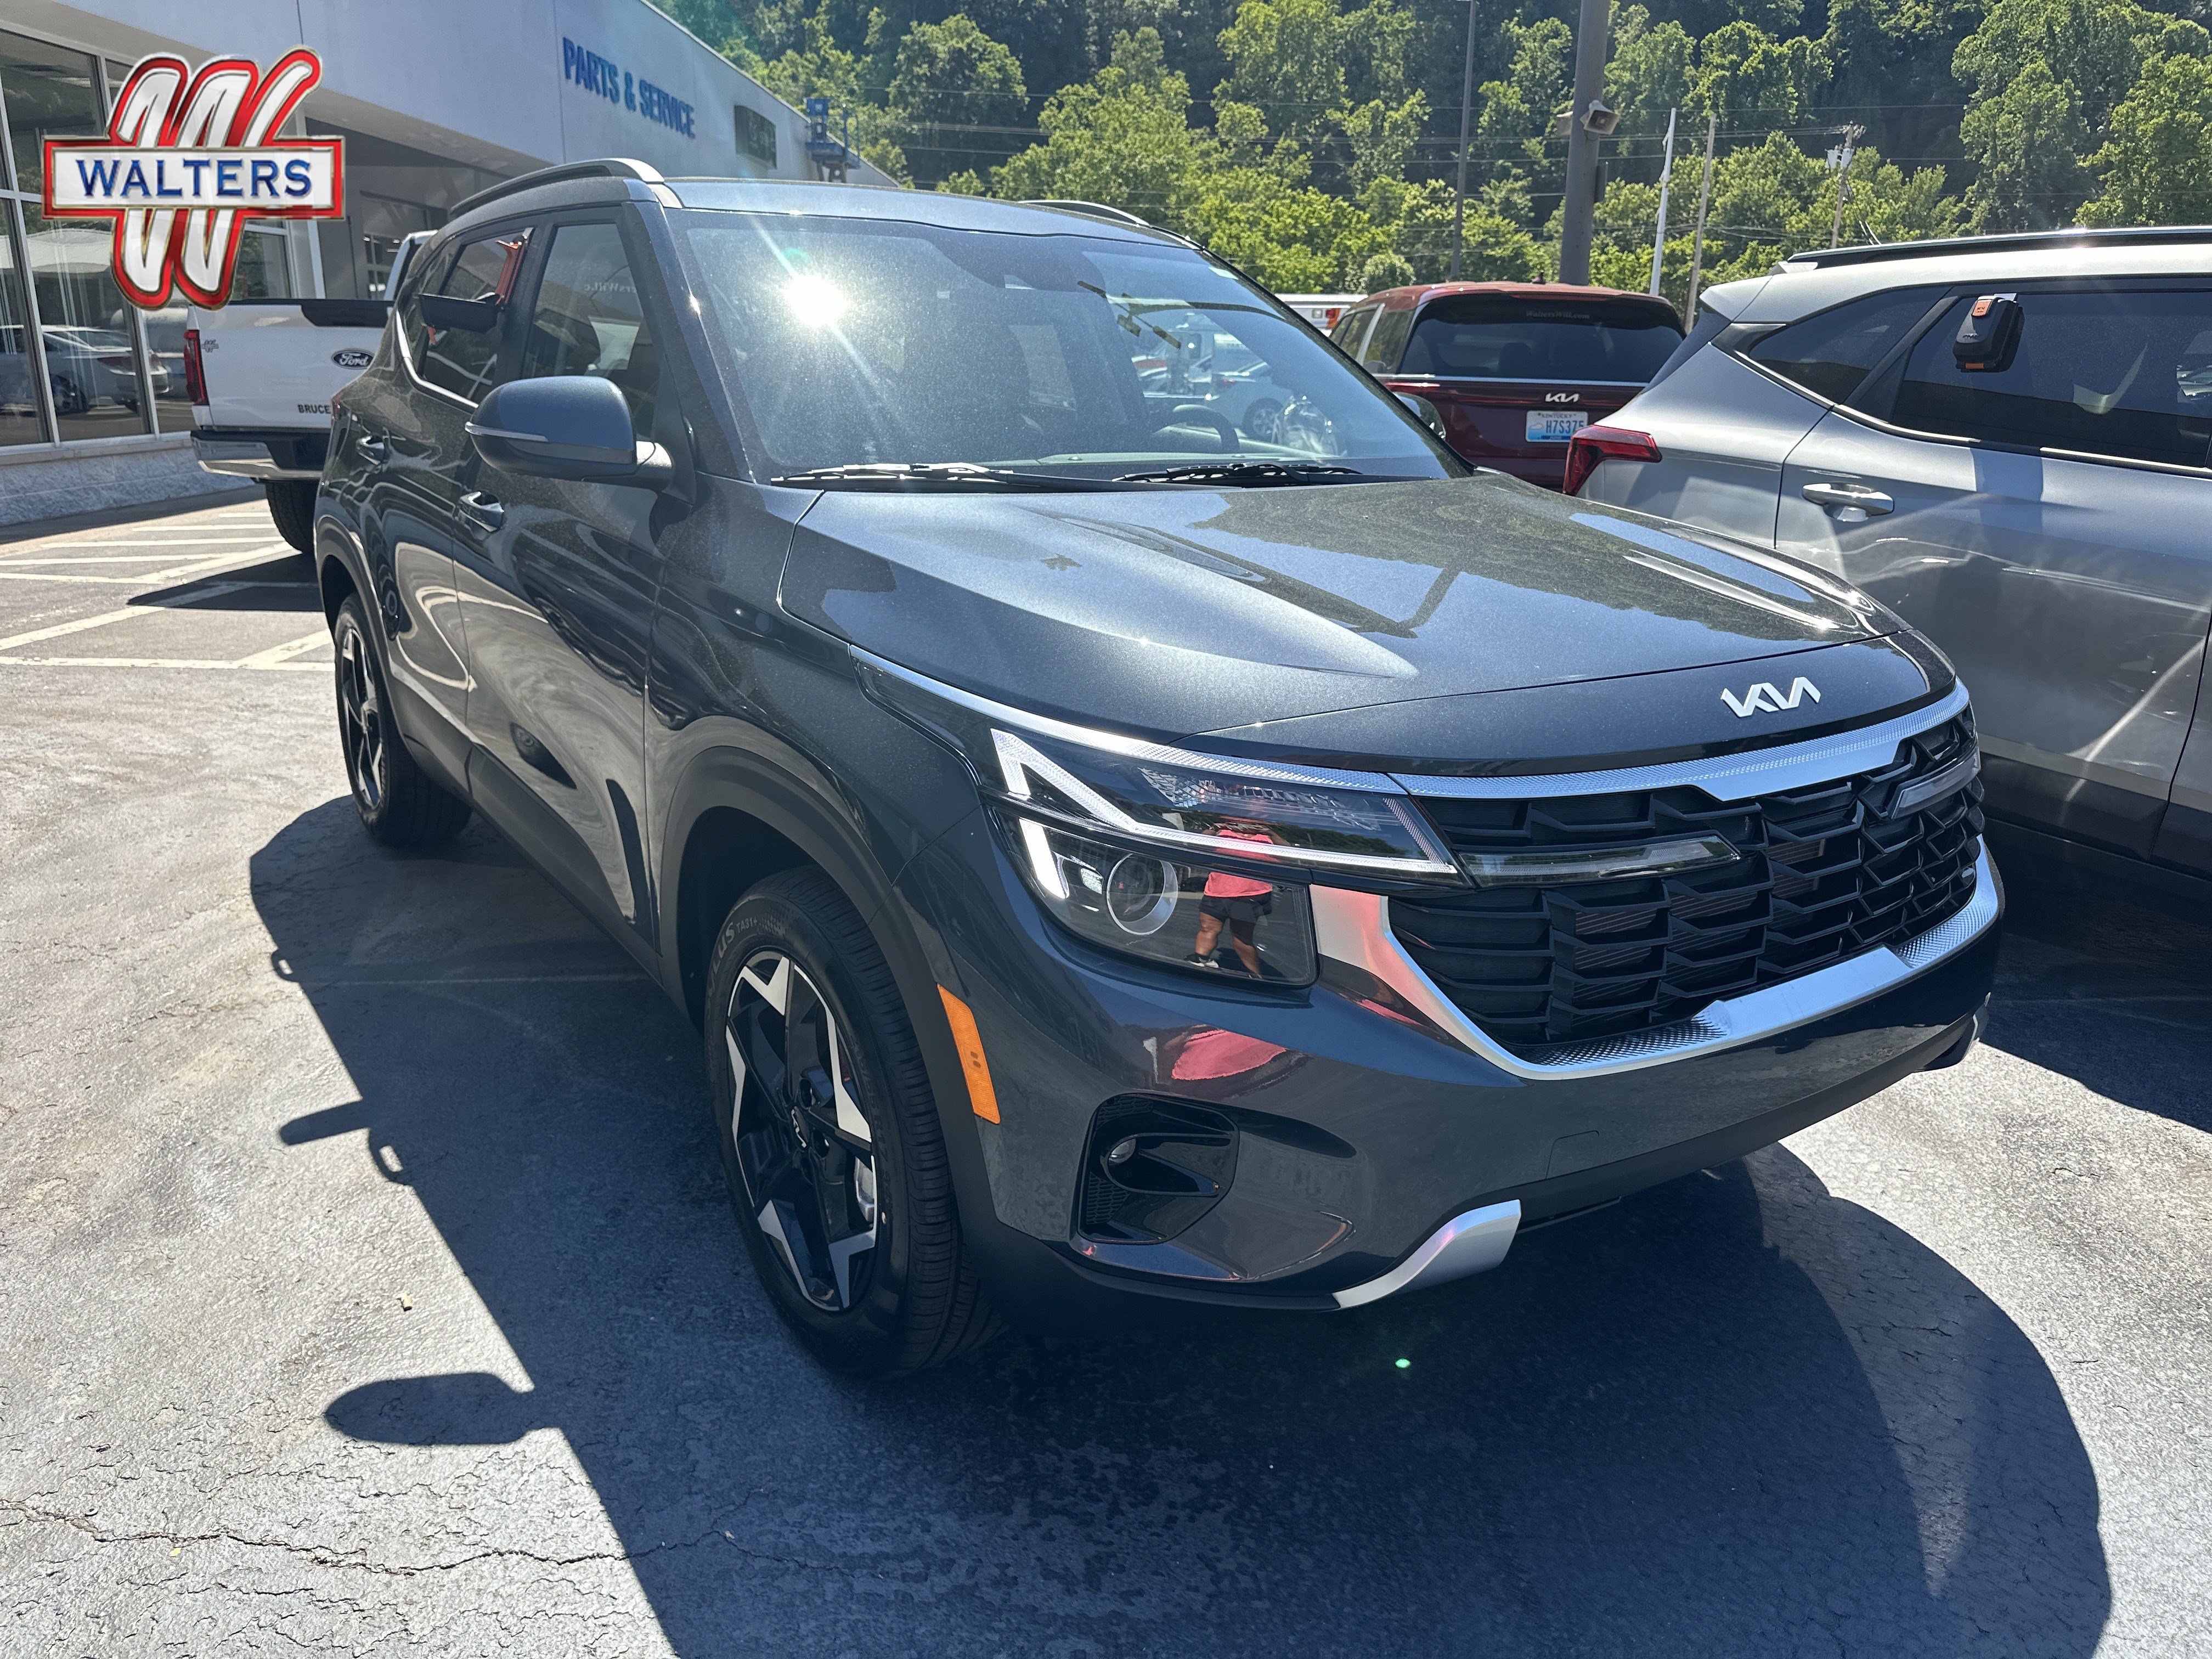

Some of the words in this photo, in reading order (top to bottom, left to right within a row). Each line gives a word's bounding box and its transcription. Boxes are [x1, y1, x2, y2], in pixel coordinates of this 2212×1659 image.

[563, 37, 620, 103] PARTS
[624, 71, 636, 112] &
[639, 79, 696, 139] SERVICE
[339, 353, 369, 366] Ford
[1545, 392, 1580, 403] KIA
[297, 404, 331, 414] BRUCE
[1720, 676, 1821, 718] KIA
